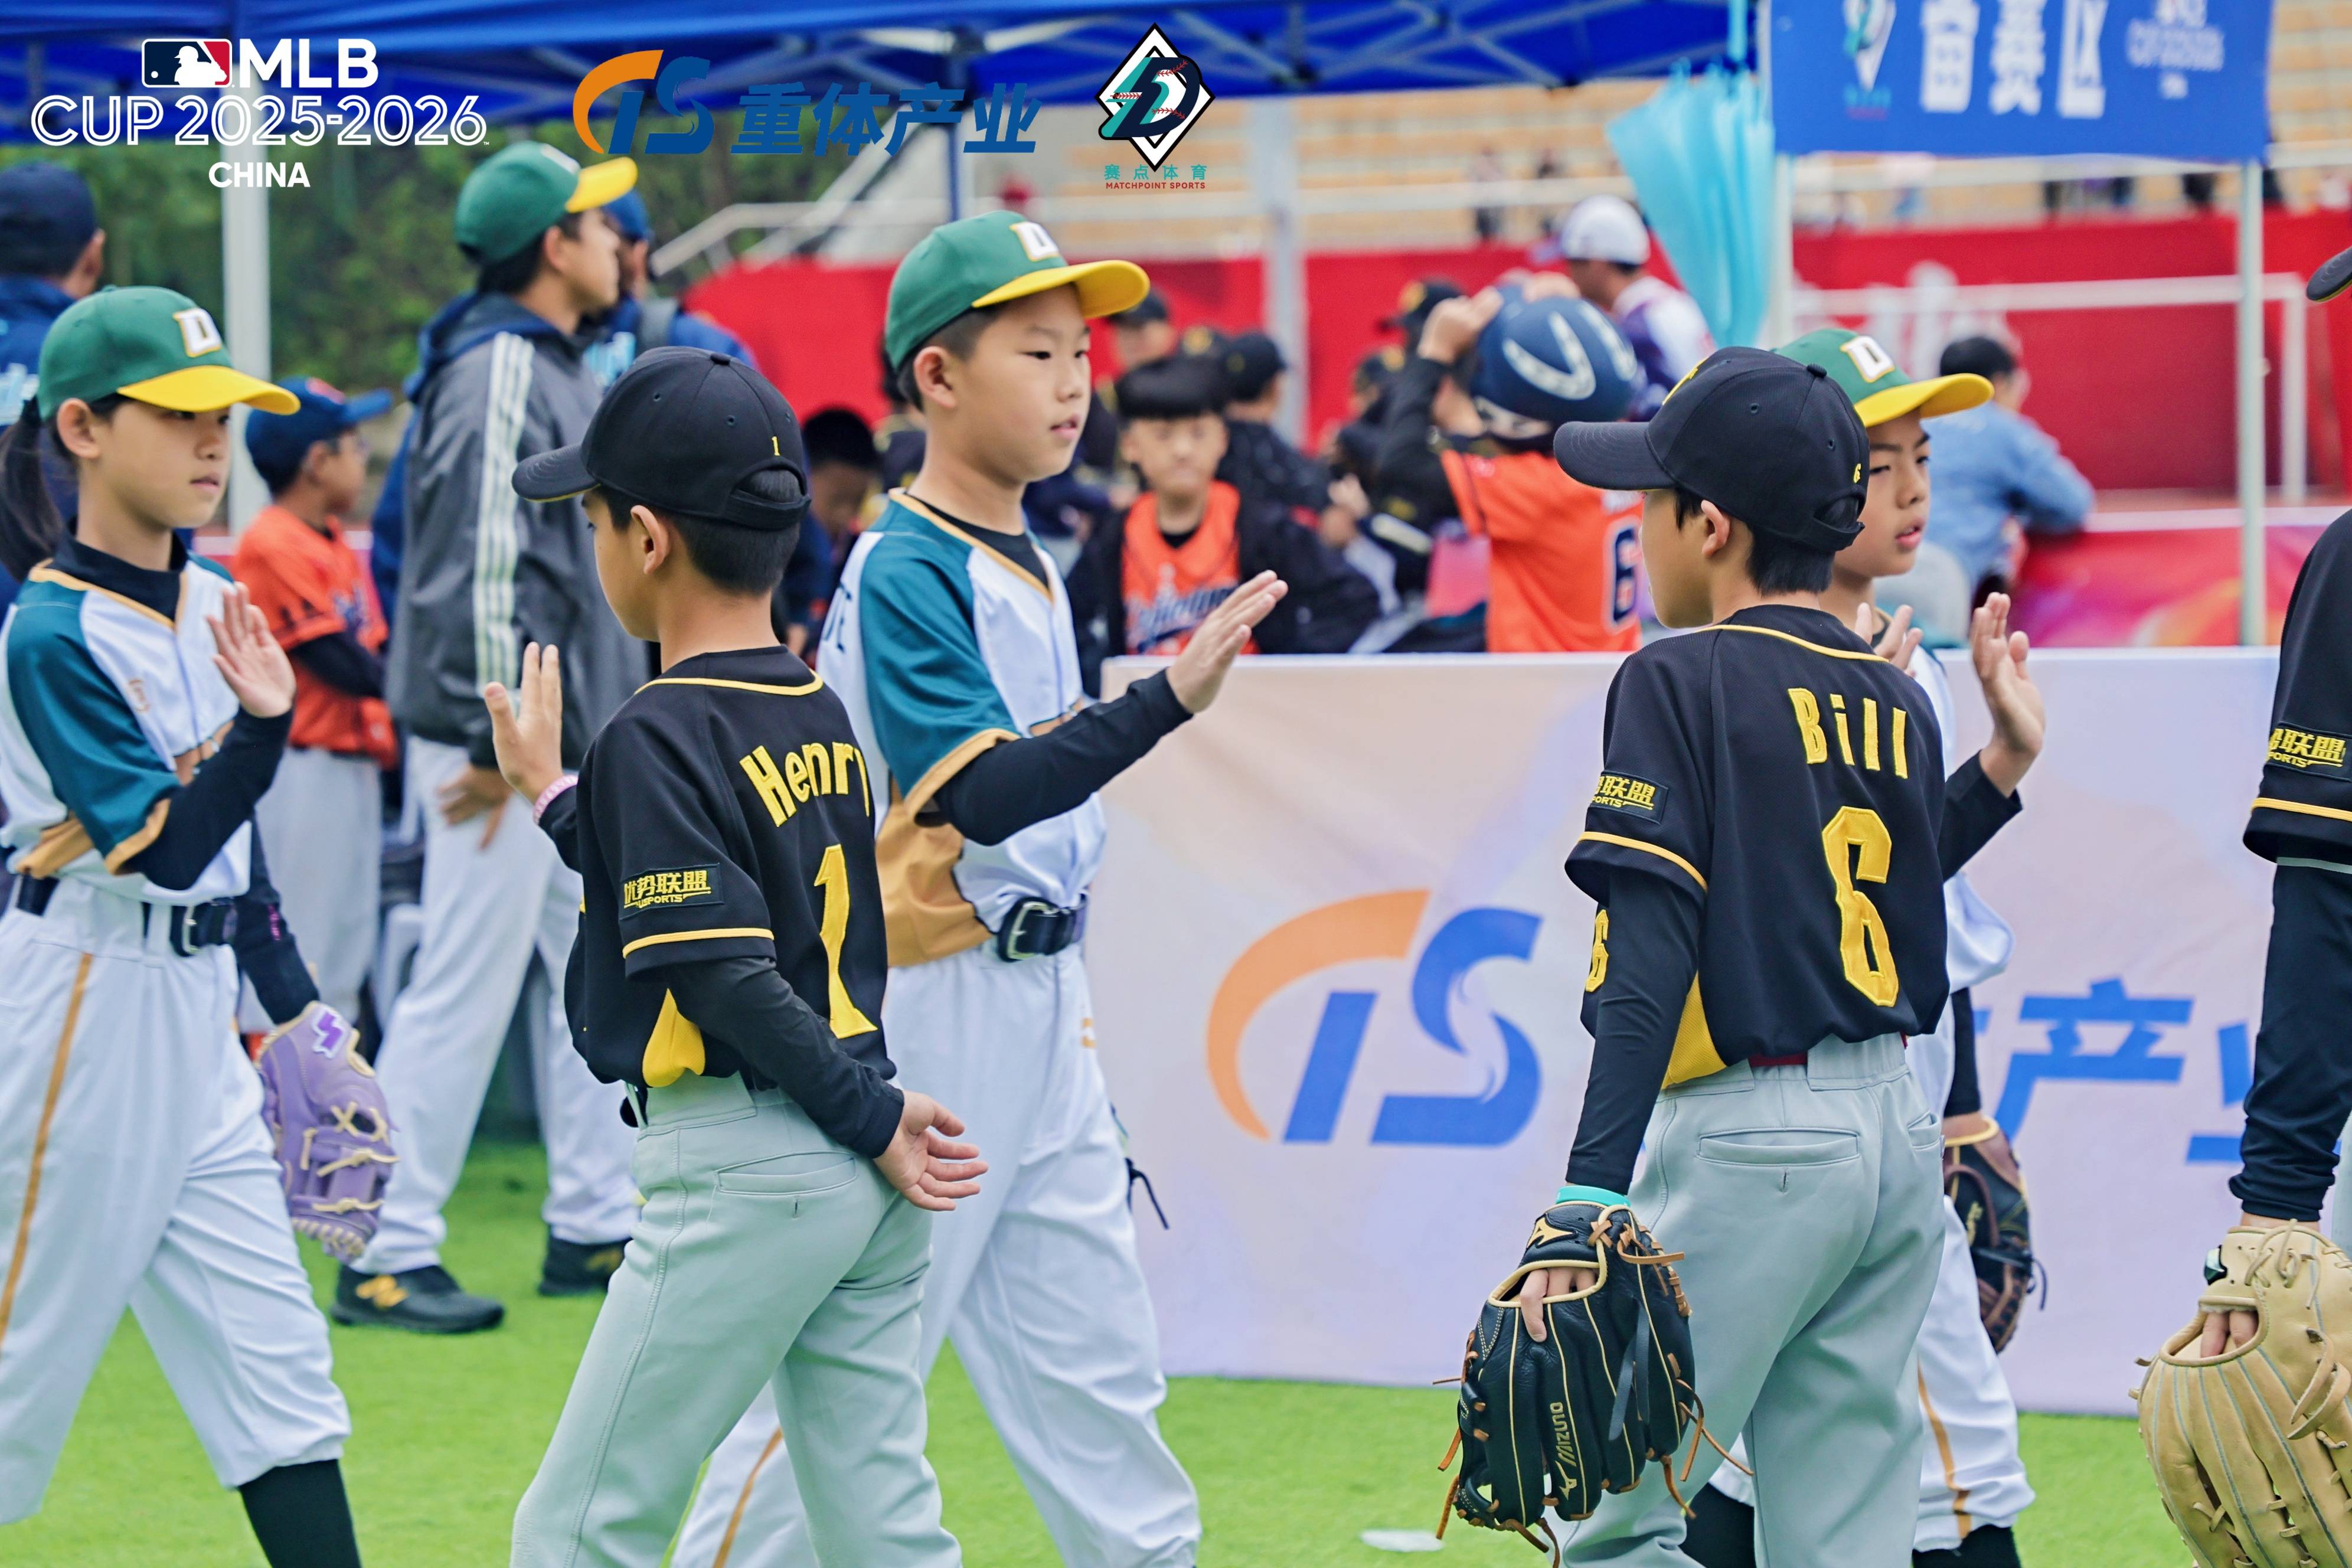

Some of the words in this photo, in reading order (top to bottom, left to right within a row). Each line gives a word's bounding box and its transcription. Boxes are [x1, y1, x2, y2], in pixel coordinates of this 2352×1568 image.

[1010, 221, 1060, 262] D
[173, 308, 222, 358] D
[1840, 335, 1896, 383] D
[772, 436, 780, 456] 1
[1853, 463, 1861, 484] 6
[1788, 688, 1909, 779] Bill
[623, 870, 711, 905] 优势联盟
[1821, 805, 1900, 1008] 6
[814, 844, 878, 1040] 1
[1585, 909, 1609, 992] 6
